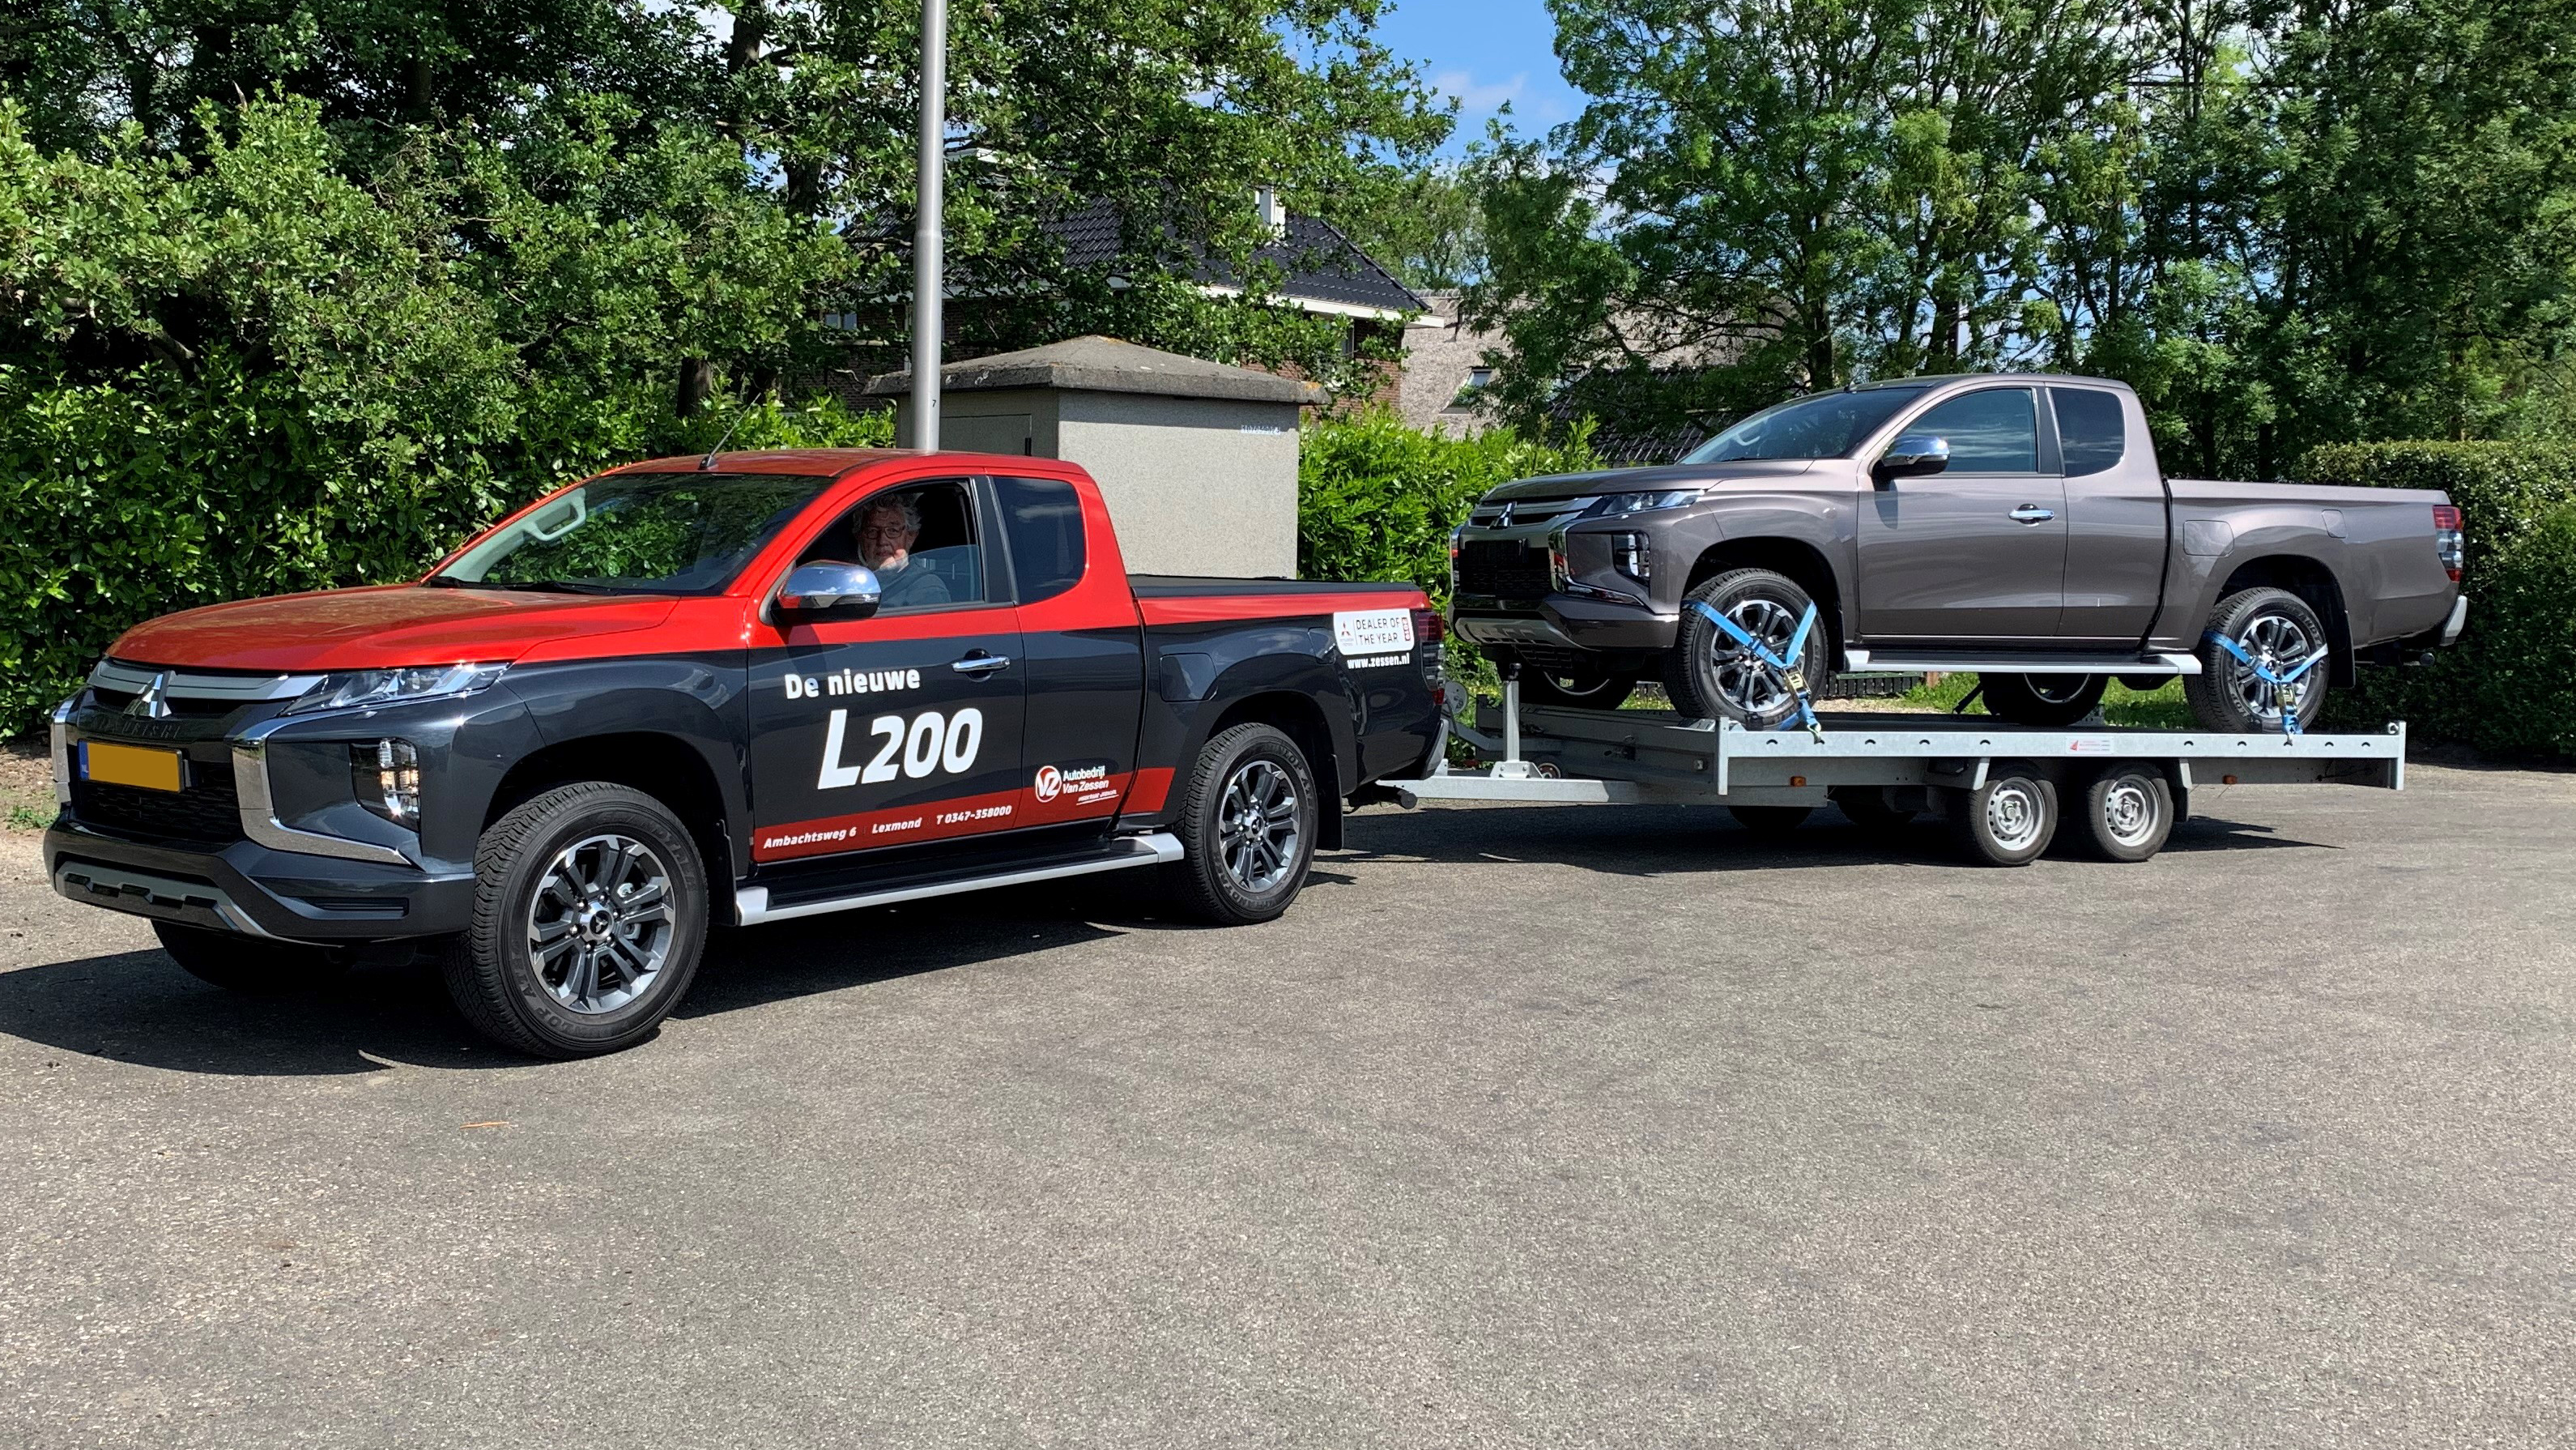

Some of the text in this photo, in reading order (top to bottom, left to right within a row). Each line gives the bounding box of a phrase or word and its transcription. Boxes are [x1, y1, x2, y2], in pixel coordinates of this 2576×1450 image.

[932, 399, 937, 407] 7
[1356, 617, 1399, 629] DEALER OF
[1359, 633, 1375, 645] THE
[1377, 632, 1398, 643] YEAR
[1347, 652, 1410, 669] www.zessen.nl
[785, 668, 921, 699] De nieuwe
[818, 707, 983, 790] L200
[1063, 766, 1105, 782] Autobedrijf
[1037, 770, 1061, 798] VZ
[1063, 779, 1109, 794] Van Zessen
[763, 805, 1012, 849] Ambachtsweg 6 Lexmond T 0347-358000
